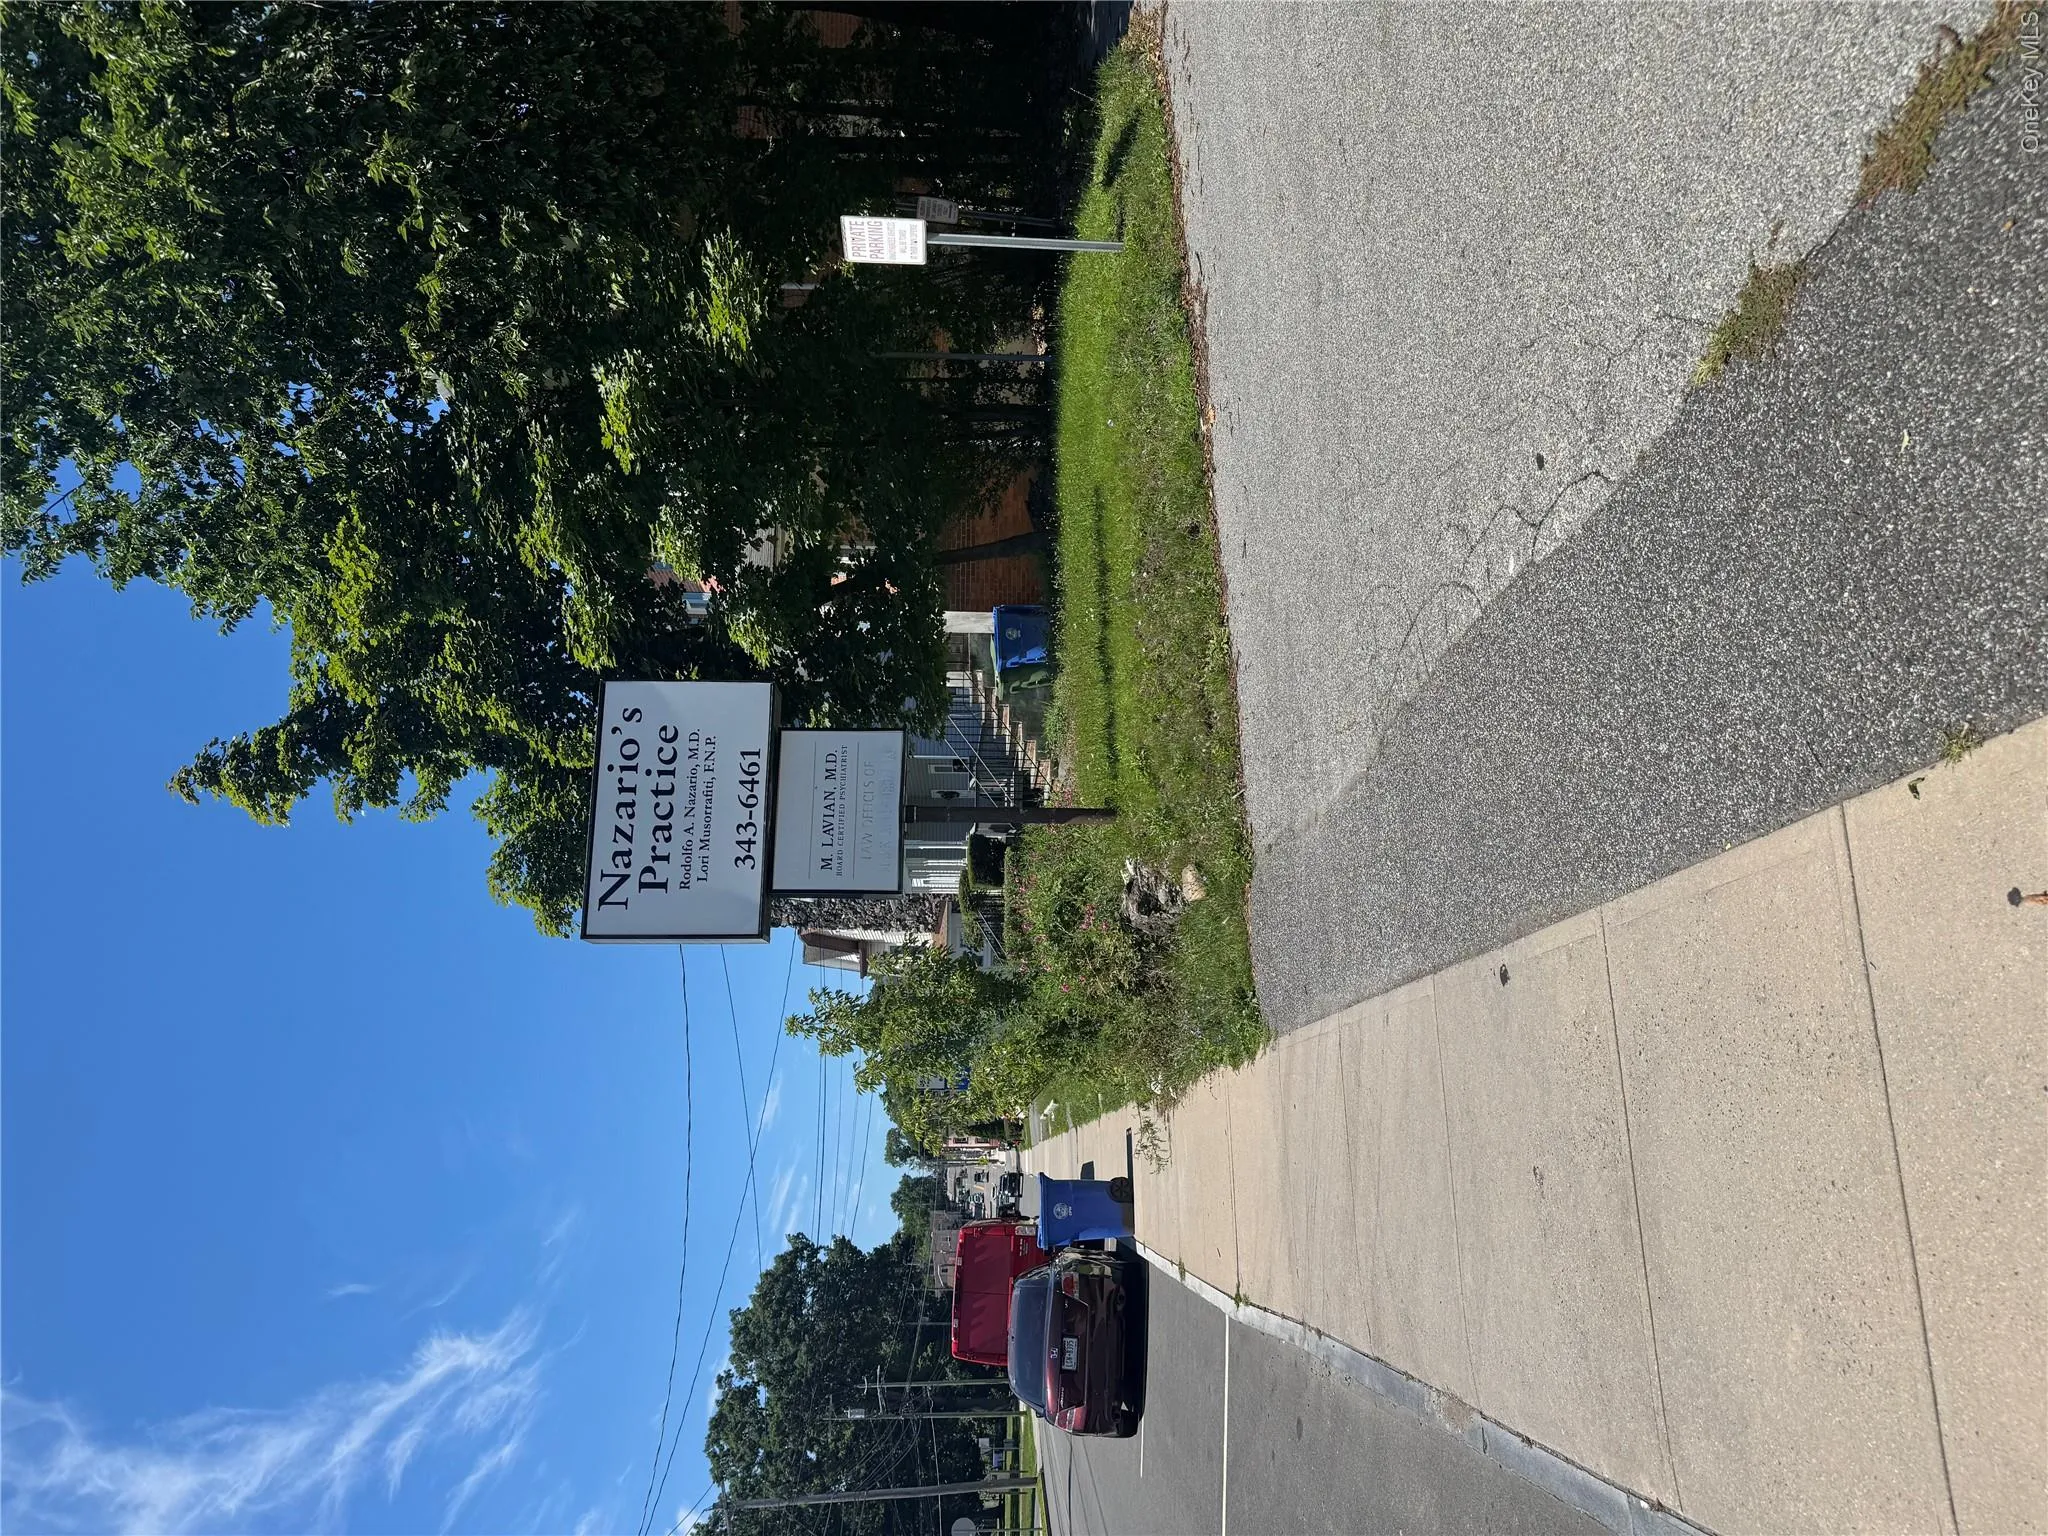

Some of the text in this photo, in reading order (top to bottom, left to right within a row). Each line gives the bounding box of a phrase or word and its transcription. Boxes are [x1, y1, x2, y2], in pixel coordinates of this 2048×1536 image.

[849, 220, 867, 258] PRIVATE
[867, 221, 885, 260] PARKING
[597, 707, 643, 911] Nazario's
[638, 725, 678, 894] Practice
[679, 728, 700, 890] Rodolfo A. Nazario, M.D.
[697, 736, 716, 882] Lori Musorrafiti, F.N.P.
[734, 748, 761, 870] 343-6461
[820, 750, 837, 870] M. LAVIAN, M.D.
[836, 745, 848, 876] BOARD CERTIFIED PSYCHIATRIST
